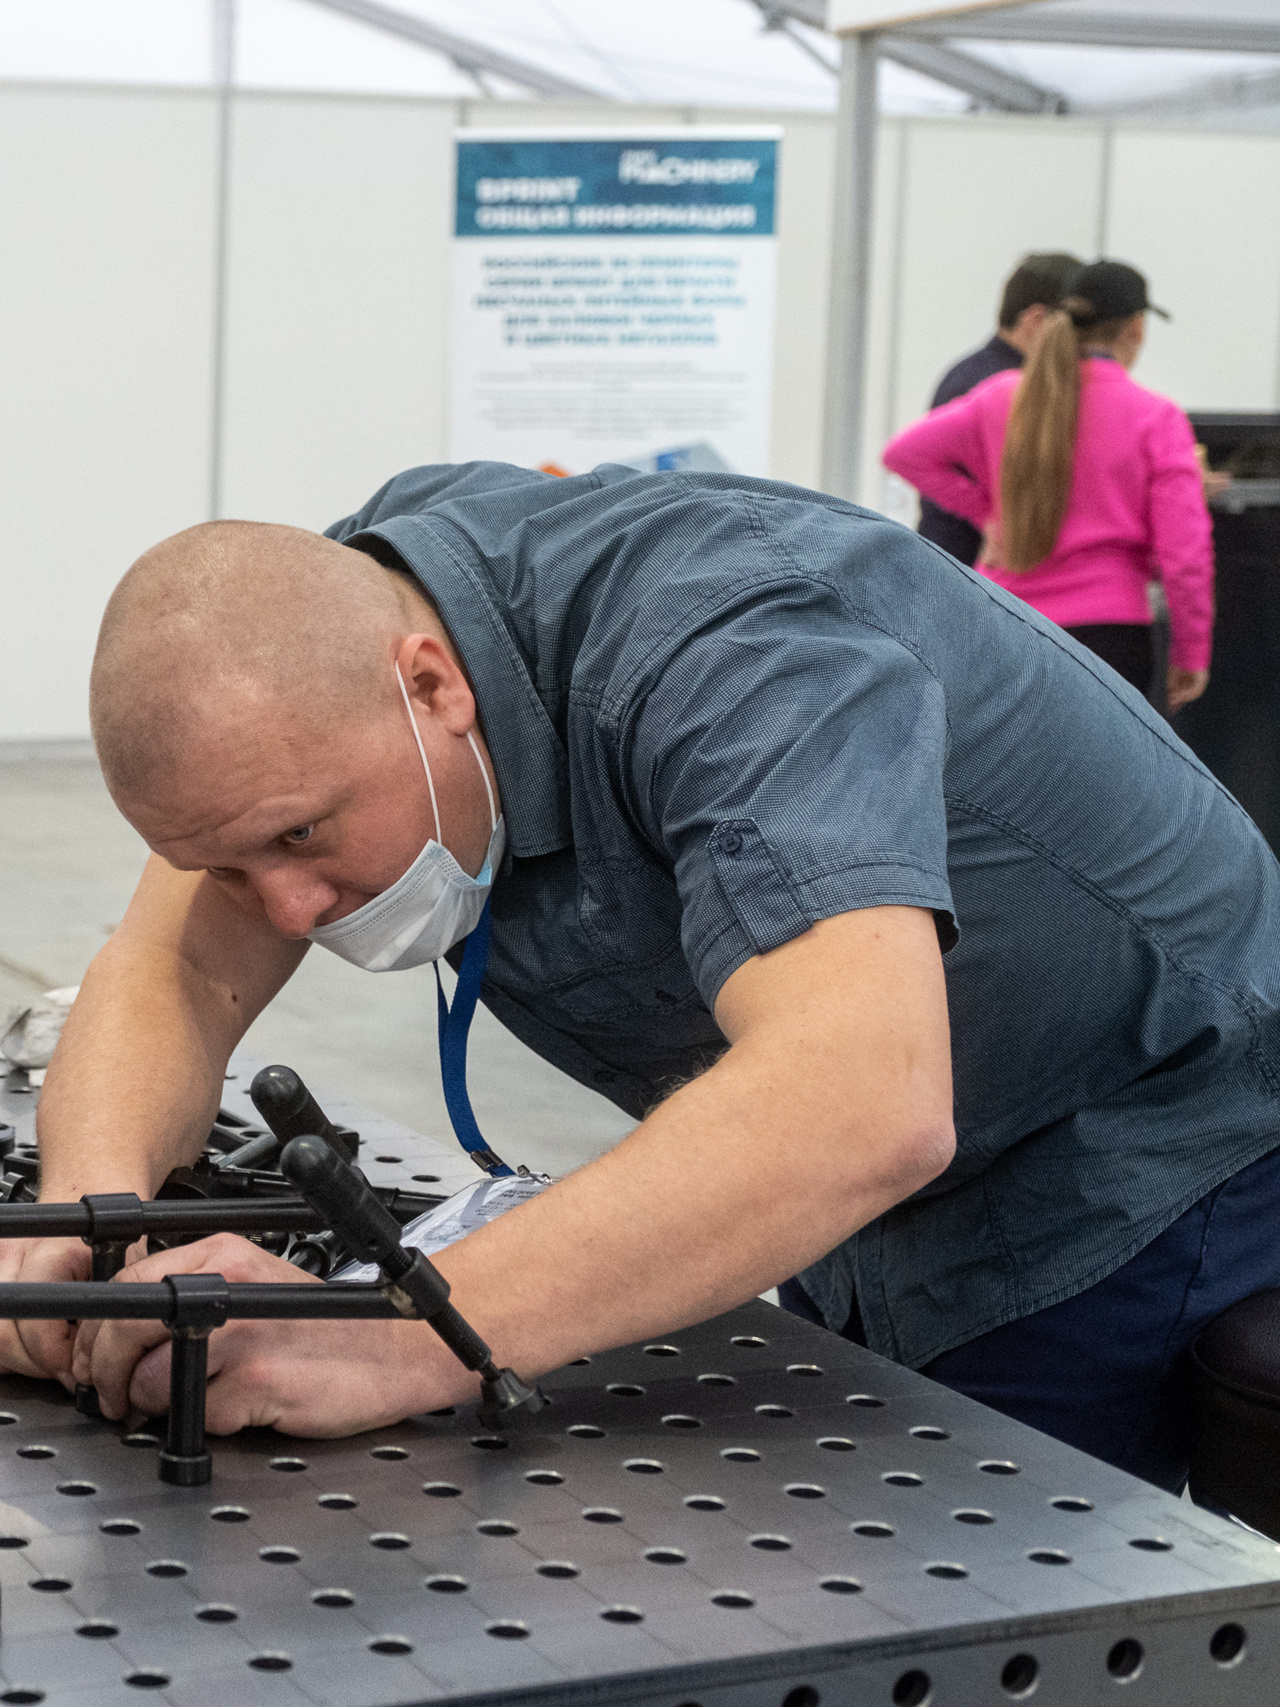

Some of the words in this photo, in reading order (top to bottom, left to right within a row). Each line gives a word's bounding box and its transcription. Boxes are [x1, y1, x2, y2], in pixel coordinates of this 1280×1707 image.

[476, 177, 581, 203] SPRINT
[475, 205, 570, 229] ОБЩАЯ
[573, 203, 756, 228] ИНФОРМАЦИЯ
